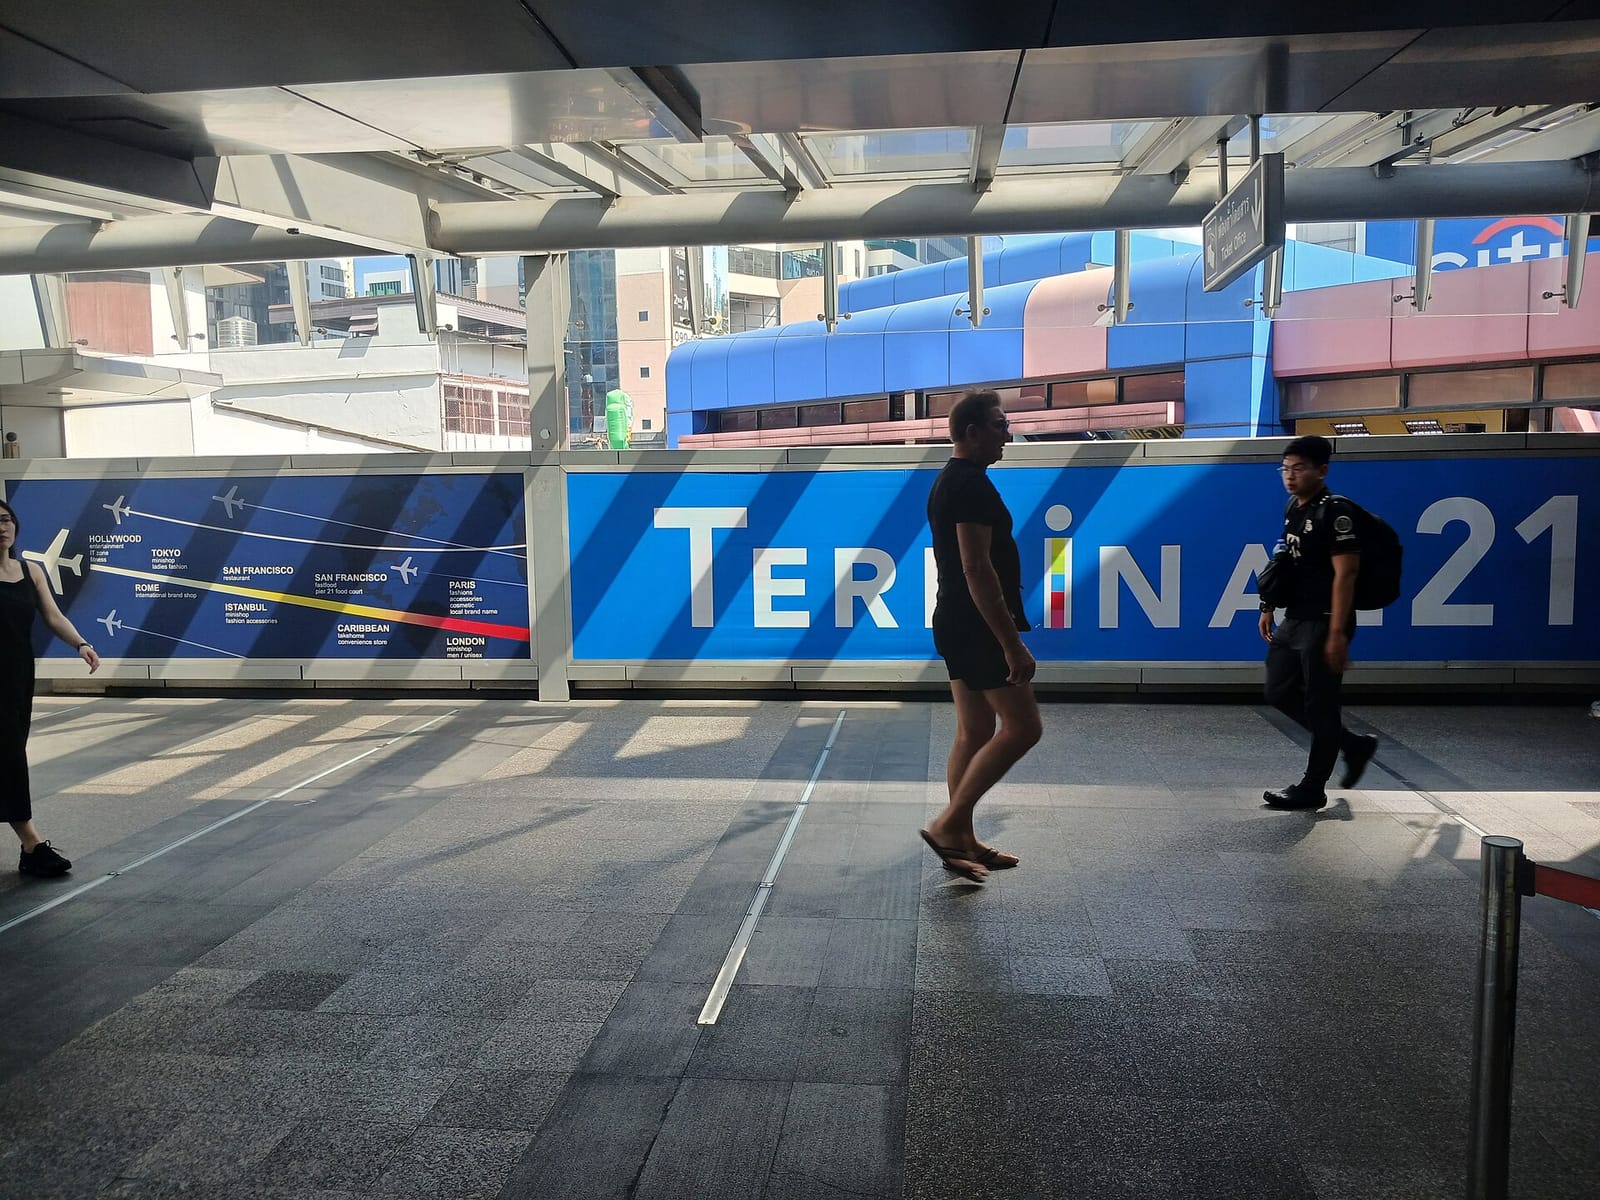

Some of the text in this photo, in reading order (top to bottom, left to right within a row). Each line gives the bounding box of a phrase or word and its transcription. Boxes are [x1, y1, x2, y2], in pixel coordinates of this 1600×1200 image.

[1221, 231, 1247, 261] Ticket Office
[89, 535, 142, 543] HOLLYWOOD
[151, 549, 181, 557] TOKYO
[654, 495, 1579, 629] TERiNA 21
[243, 567, 294, 575] FRANCISCO
[135, 584, 160, 592] ROME
[225, 603, 268, 611] ISTANBUL
[337, 624, 390, 632] CARIBBEAN
